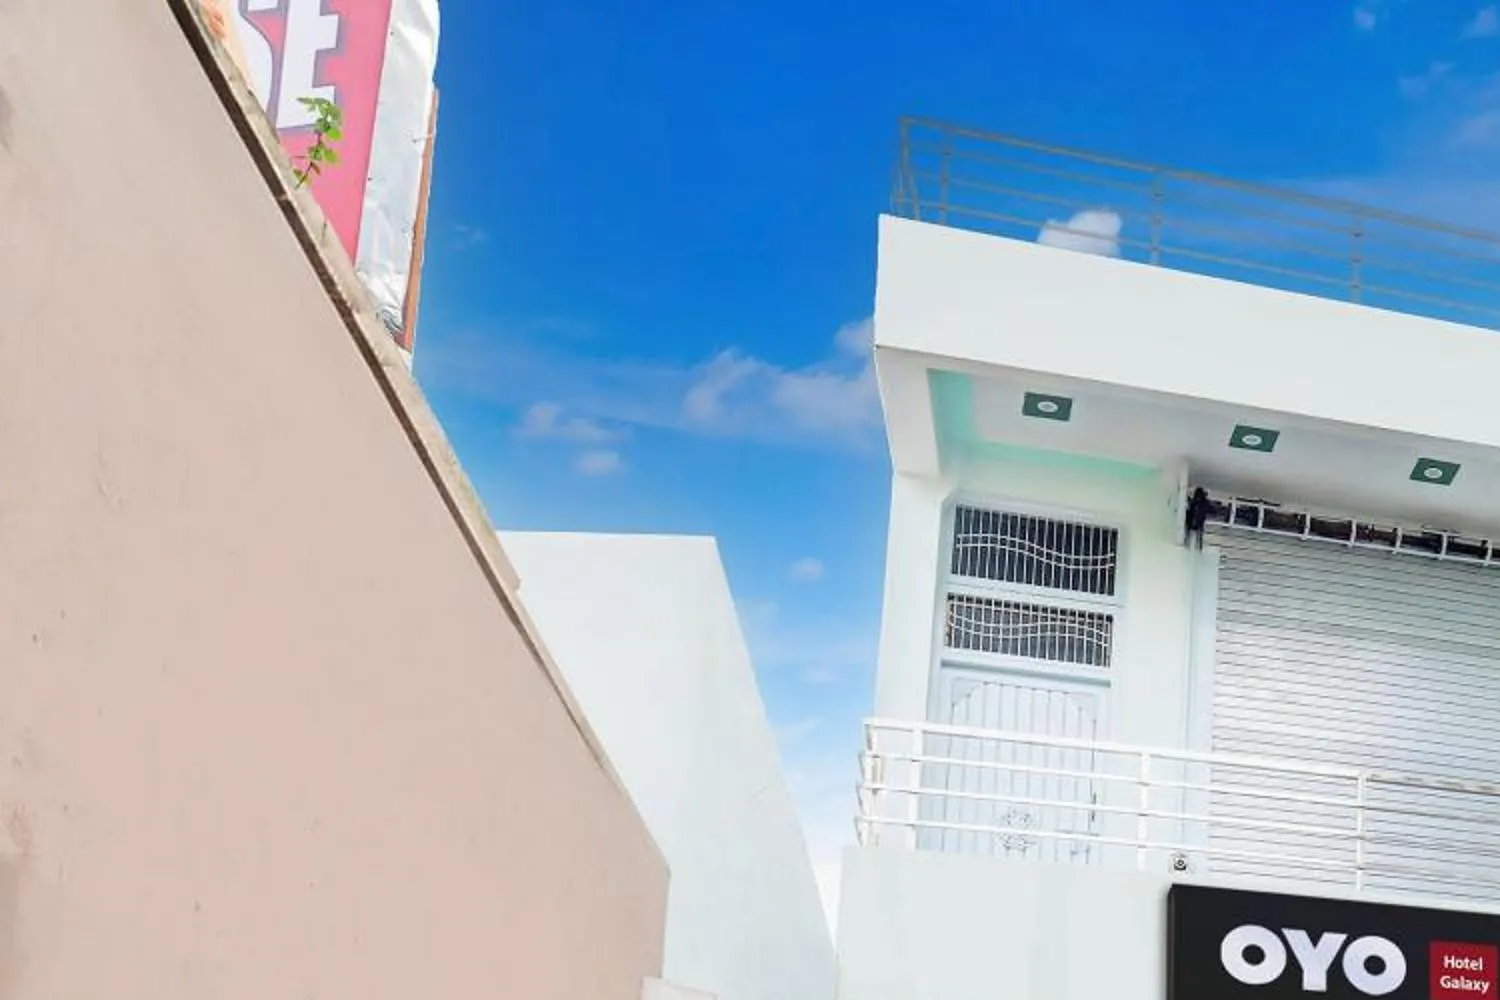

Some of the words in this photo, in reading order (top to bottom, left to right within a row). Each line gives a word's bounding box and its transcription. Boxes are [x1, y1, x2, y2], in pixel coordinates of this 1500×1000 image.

[1220, 924, 1407, 996] OYO
[1443, 955, 1483, 971] Hotel
[1439, 975, 1490, 994] Galaxy
